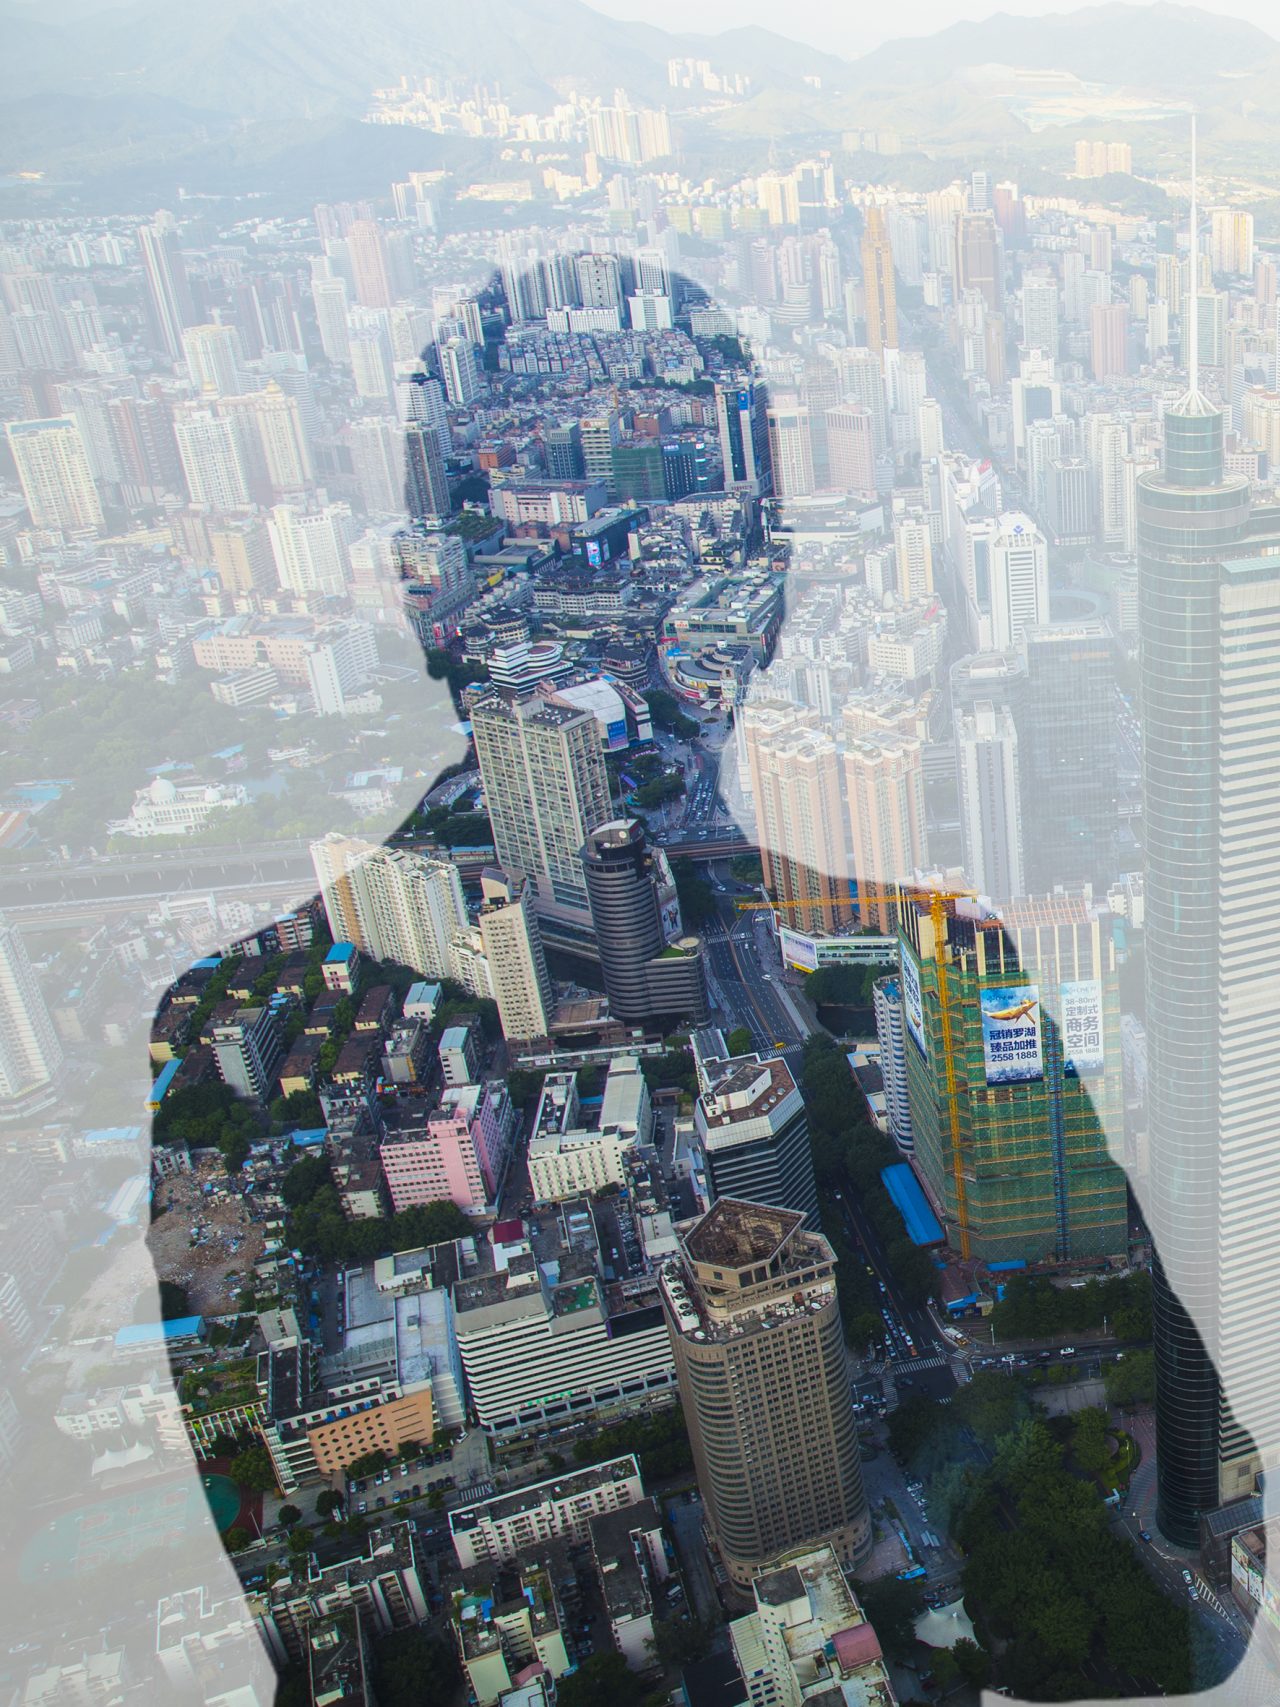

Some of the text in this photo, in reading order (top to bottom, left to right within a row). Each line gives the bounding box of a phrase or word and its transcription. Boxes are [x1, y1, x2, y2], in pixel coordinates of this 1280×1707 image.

[1065, 1004, 1099, 1016] 定制式
[1065, 1016, 1099, 1033] 商务
[989, 1027, 1036, 1040] 冠销罗湖
[1066, 1032, 1100, 1048] 空间
[990, 1039, 1037, 1053] 臻品加推
[991, 1051, 1038, 1062] 2558 1888
